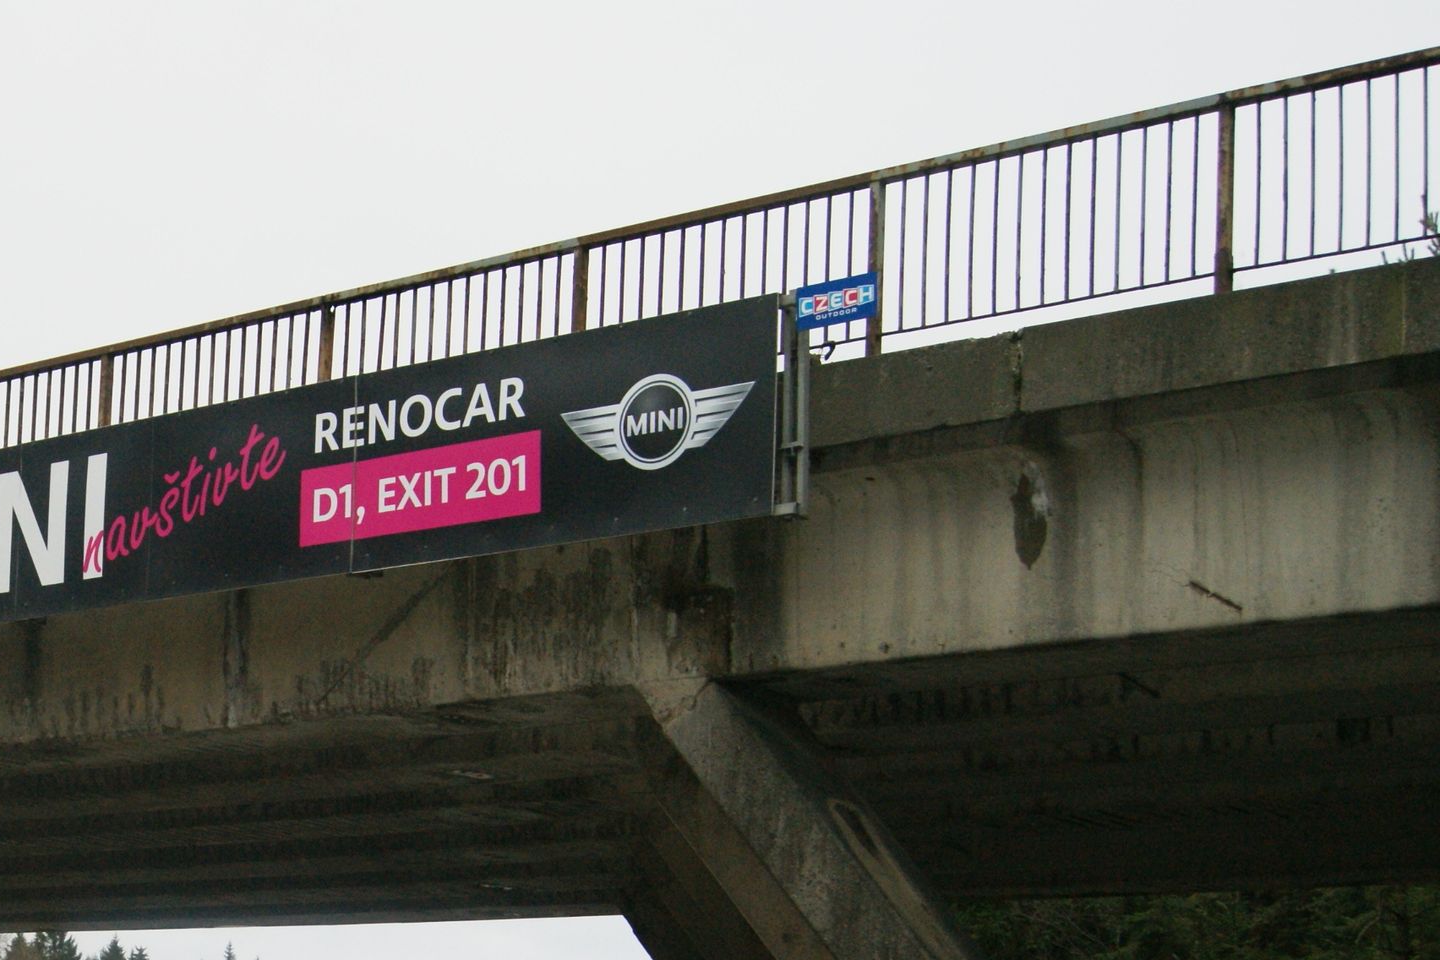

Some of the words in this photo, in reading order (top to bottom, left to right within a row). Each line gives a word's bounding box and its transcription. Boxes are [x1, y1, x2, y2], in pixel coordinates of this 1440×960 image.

[800, 285, 873, 316] CZECH
[815, 307, 858, 320] OUTDOOR
[313, 376, 526, 455] RENOCAR
[626, 405, 684, 438] MINI
[82, 423, 287, 573] navštivte
[312, 483, 366, 525] D1,
[378, 465, 457, 513] EXIT
[465, 454, 527, 501] 201
